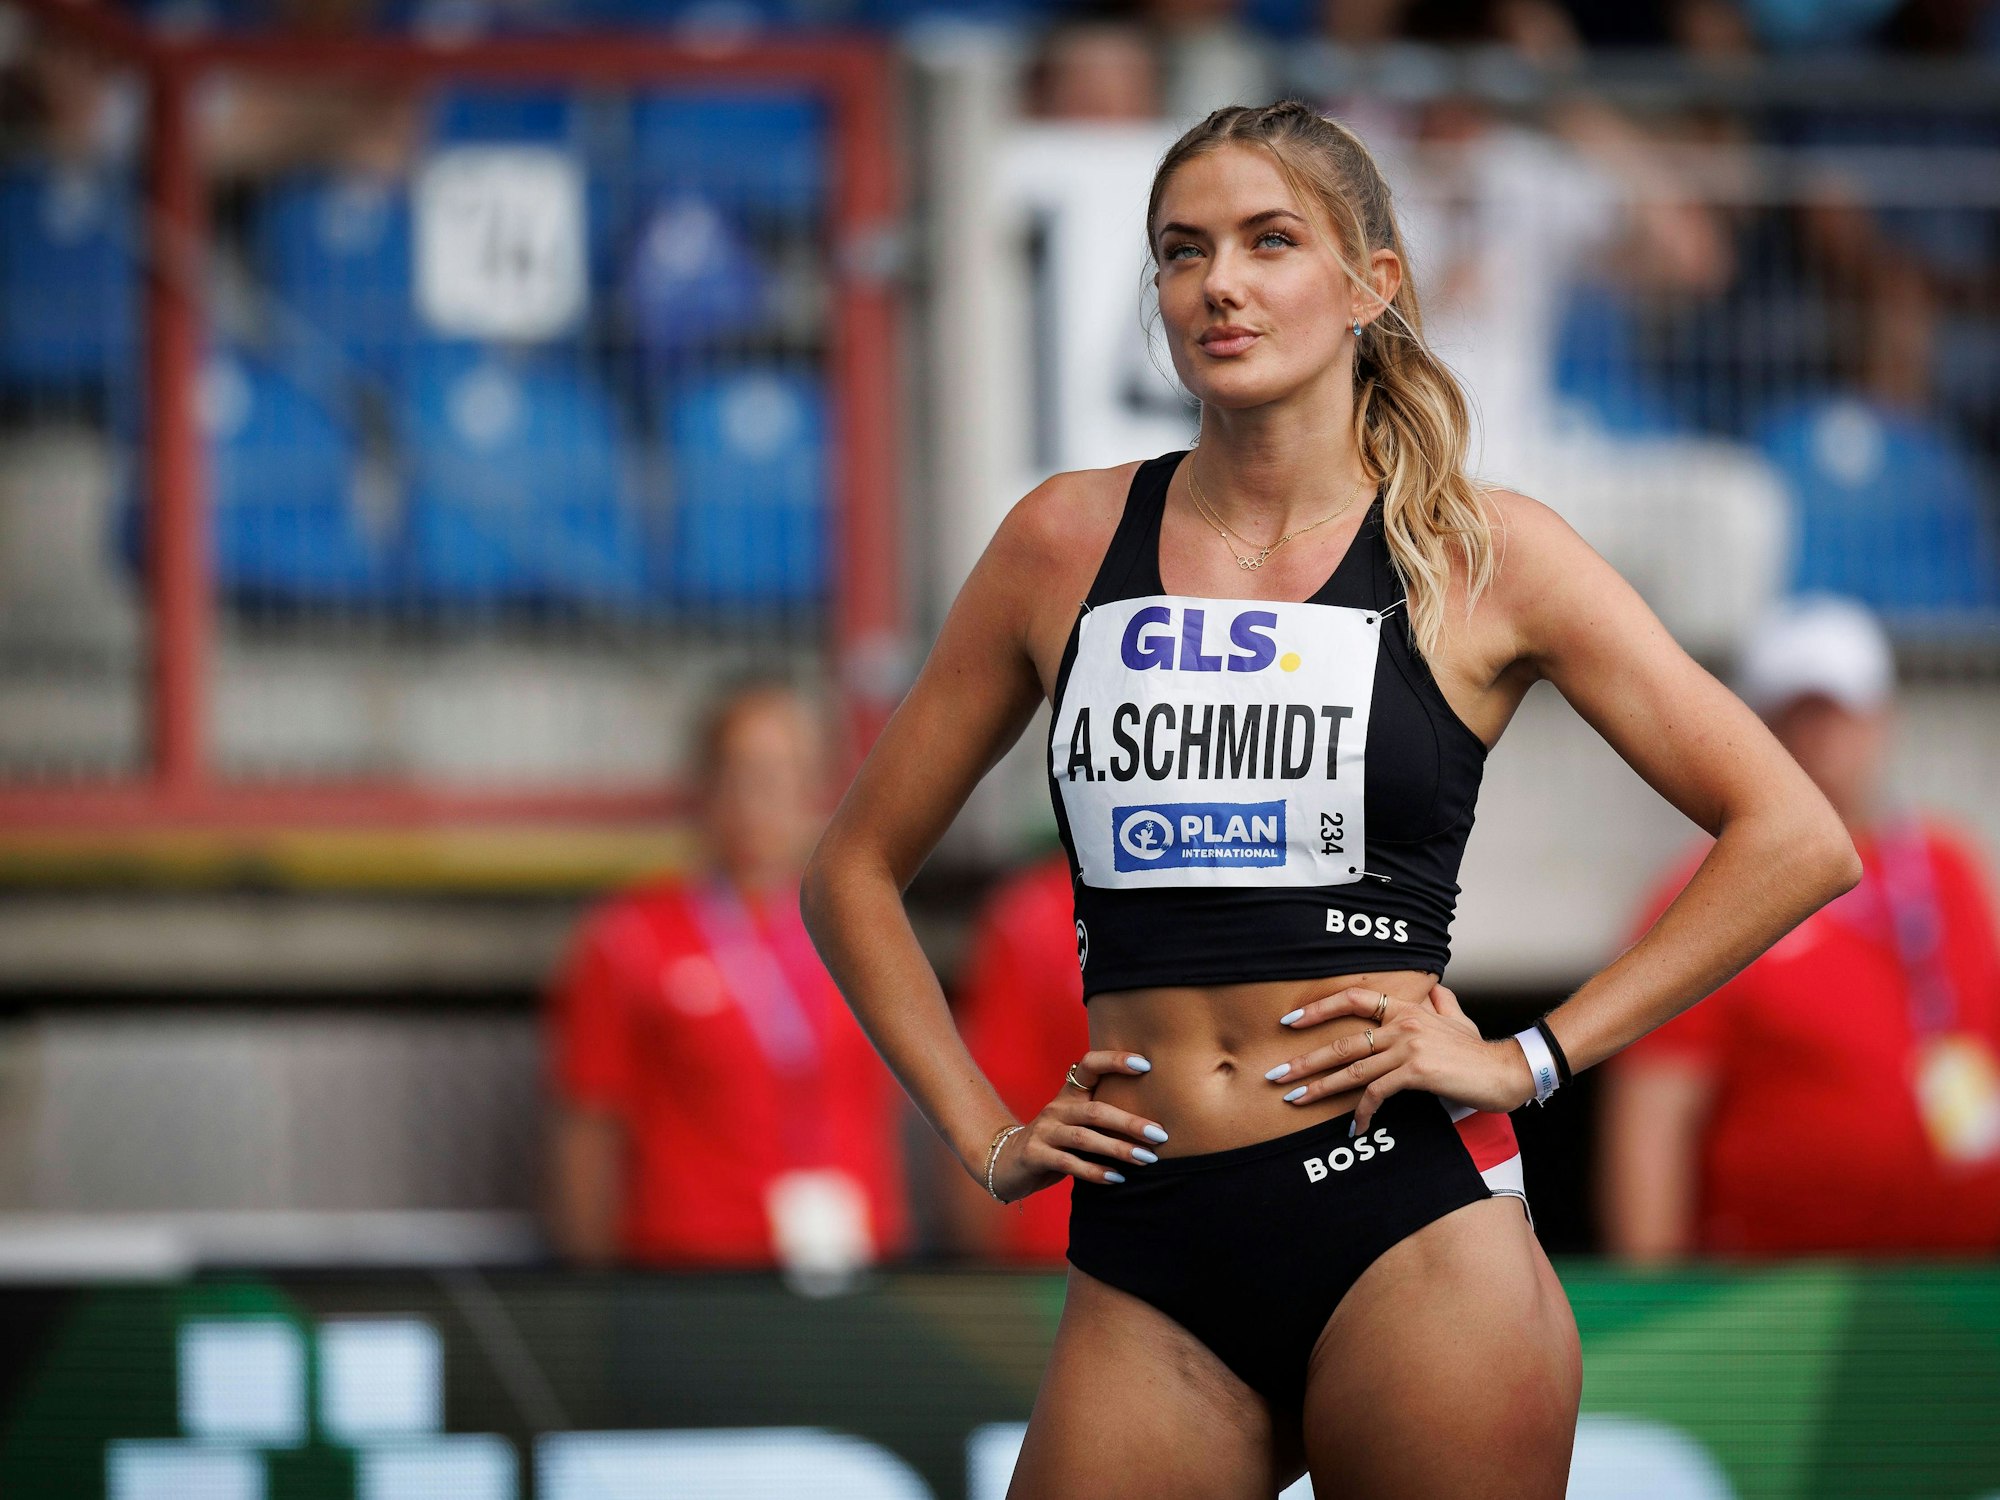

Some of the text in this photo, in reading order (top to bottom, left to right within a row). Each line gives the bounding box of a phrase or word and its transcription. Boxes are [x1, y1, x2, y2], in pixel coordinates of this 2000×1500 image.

[1067, 702, 1354, 782] A.SCHMIDT
[1180, 815, 1278, 843] PLAN
[1320, 812, 1344, 856] 234
[1181, 848, 1279, 859] INTERNATIONAL
[1325, 908, 1409, 943] BOSS
[1303, 1127, 1396, 1184] BOSS
